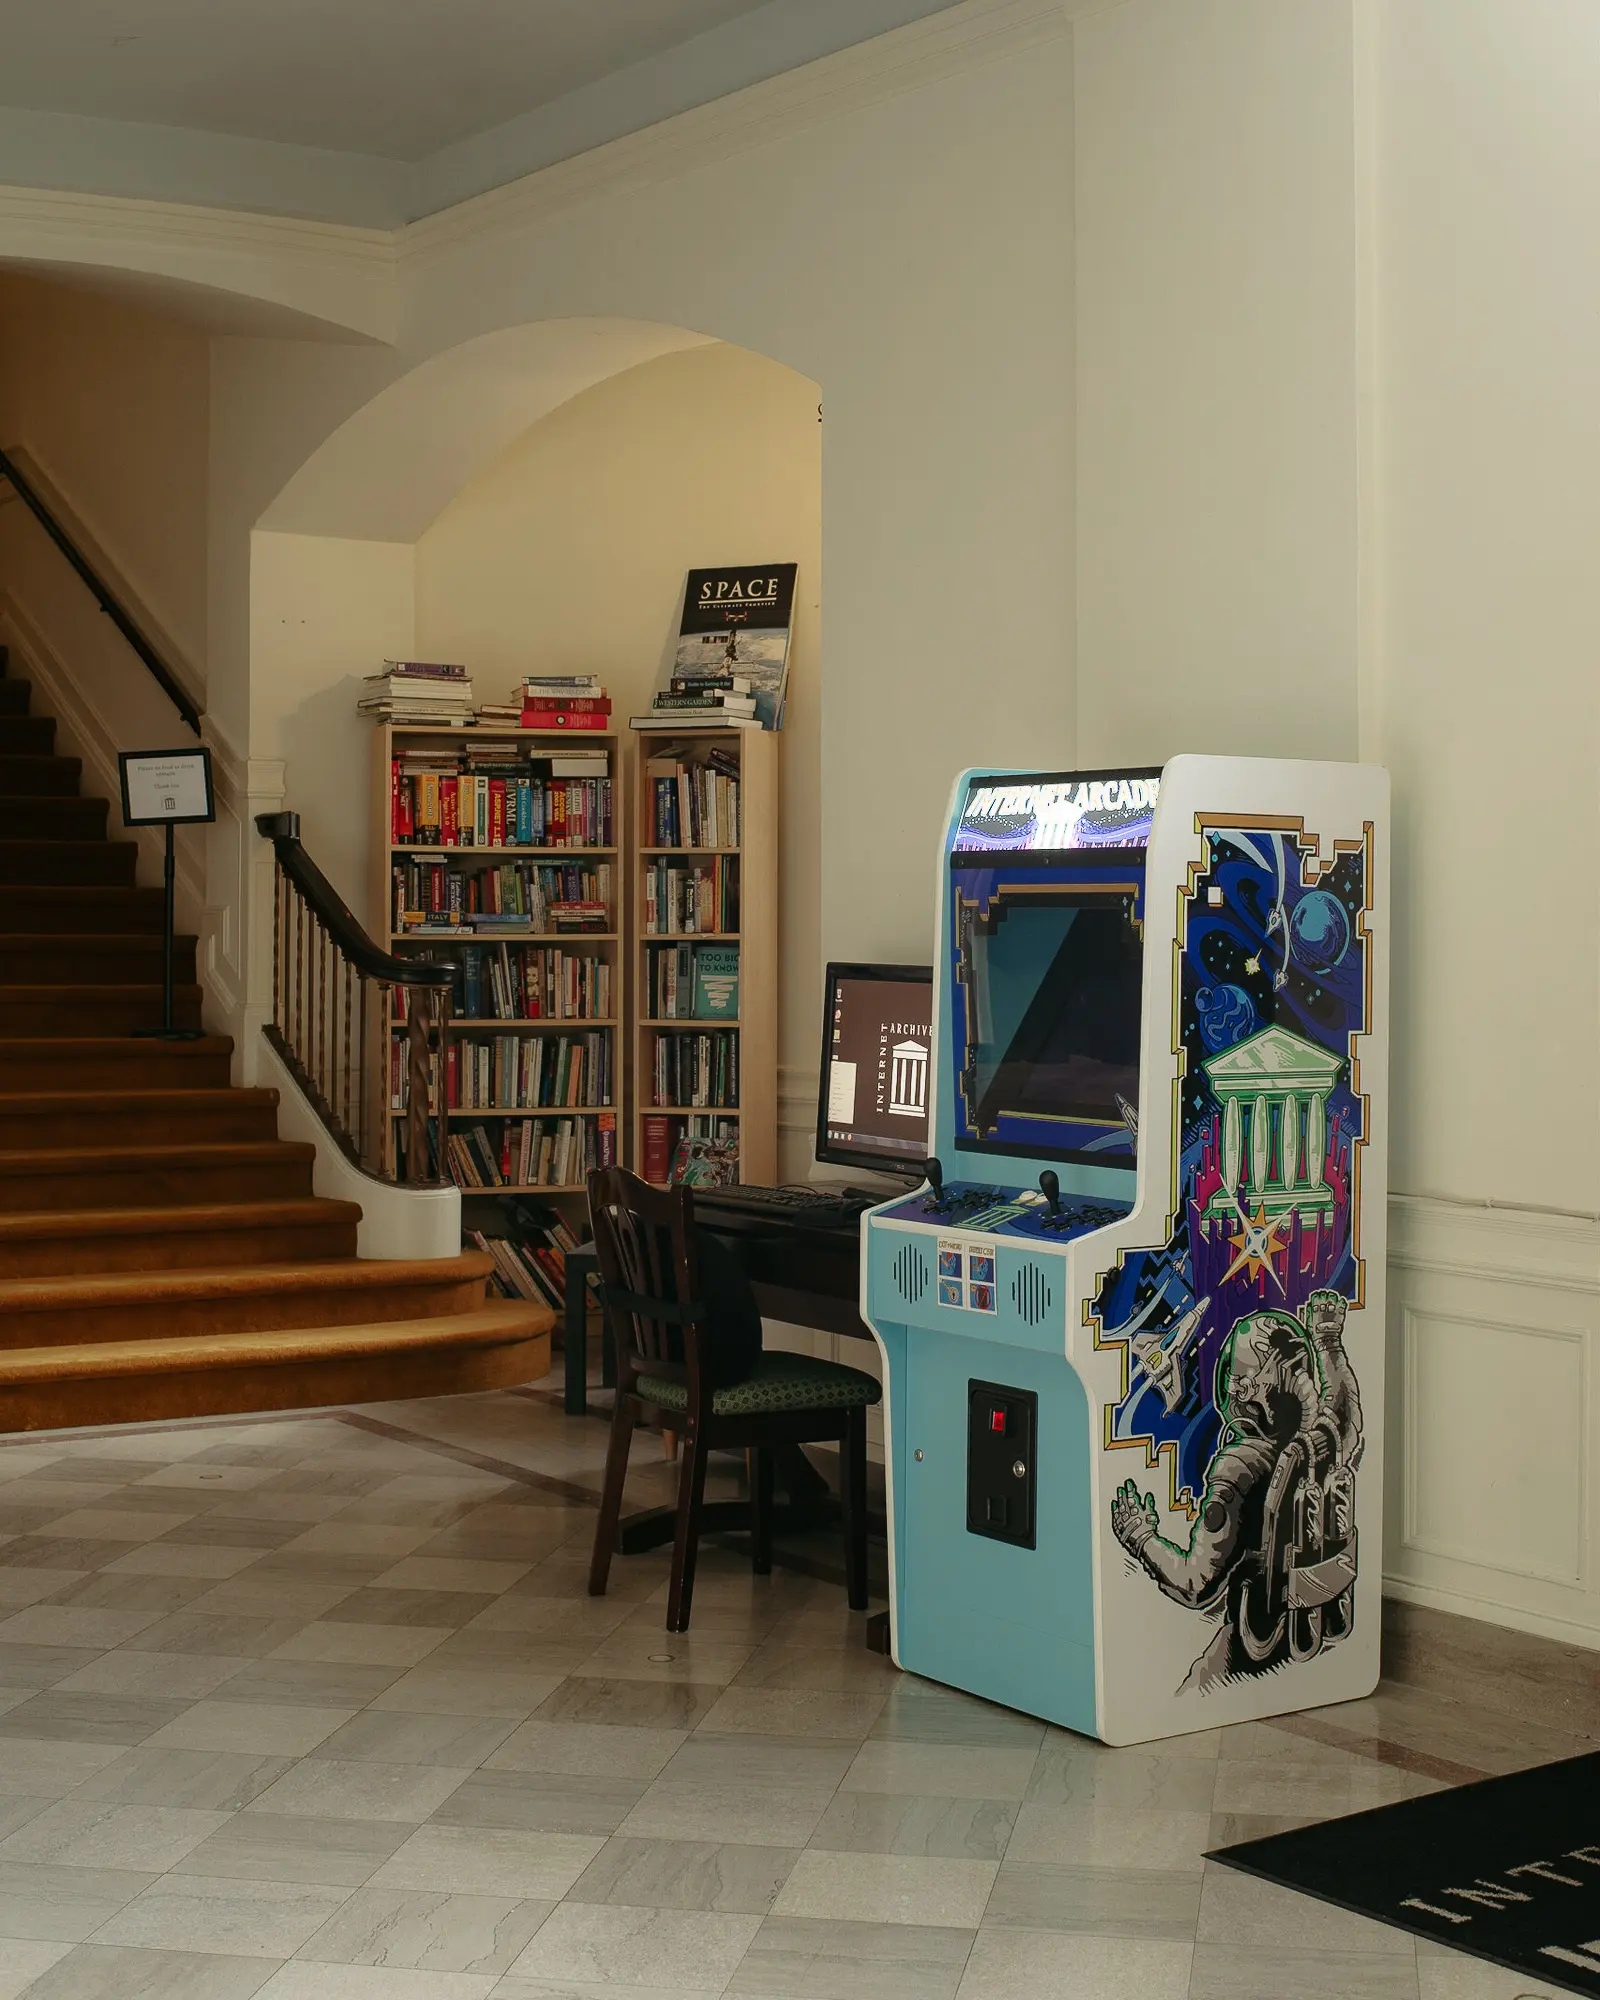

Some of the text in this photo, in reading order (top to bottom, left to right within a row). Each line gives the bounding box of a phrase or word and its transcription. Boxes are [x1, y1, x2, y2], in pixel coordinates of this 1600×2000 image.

[700, 578, 778, 600] SPACE
[658, 697, 713, 706] WESTERN GARDEN
[506, 793, 517, 825] VRML
[699, 953, 722, 962] TOO
[700, 964, 712, 972] TO
[889, 1022, 933, 1037] ARCHIVE
[876, 1022, 889, 1113] INTERNET
